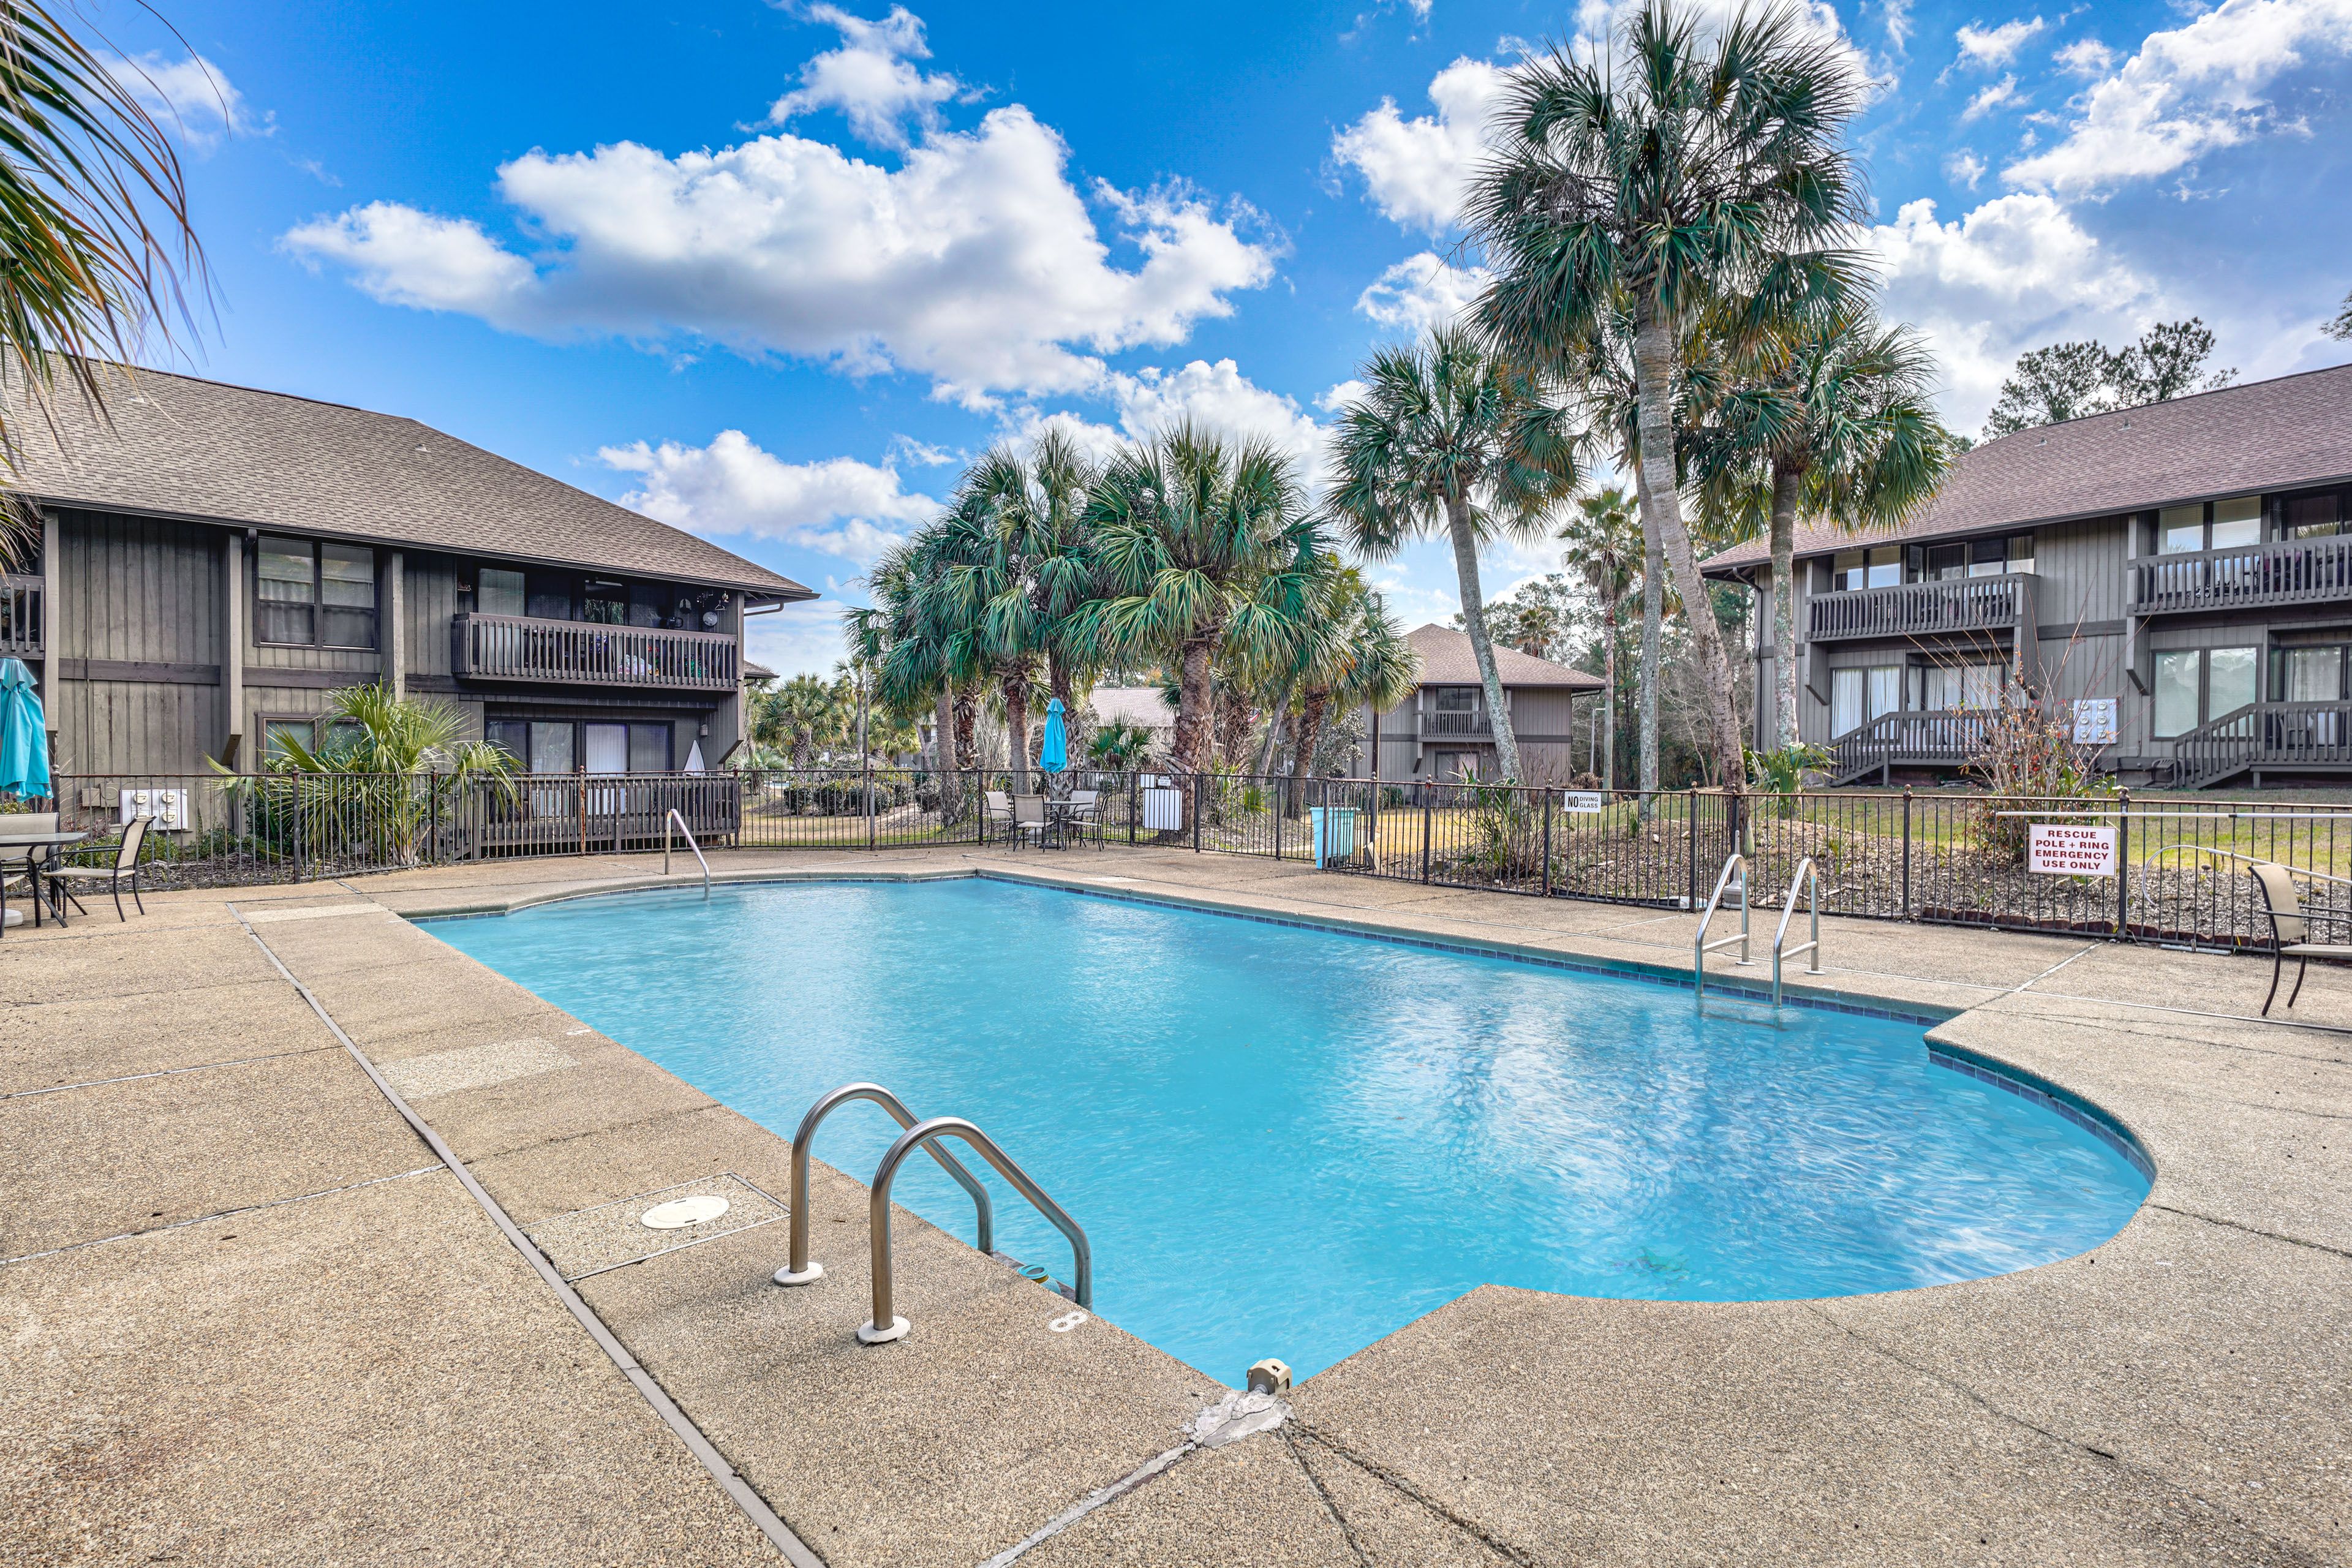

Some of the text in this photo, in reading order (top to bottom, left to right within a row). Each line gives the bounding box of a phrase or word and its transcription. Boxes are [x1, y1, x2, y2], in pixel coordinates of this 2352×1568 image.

[1568, 796, 1578, 807] NO
[2048, 830, 2097, 839] RESCUE
[2035, 850, 2108, 860] EMERGENCY
[2070, 861, 2101, 870] ONLY
